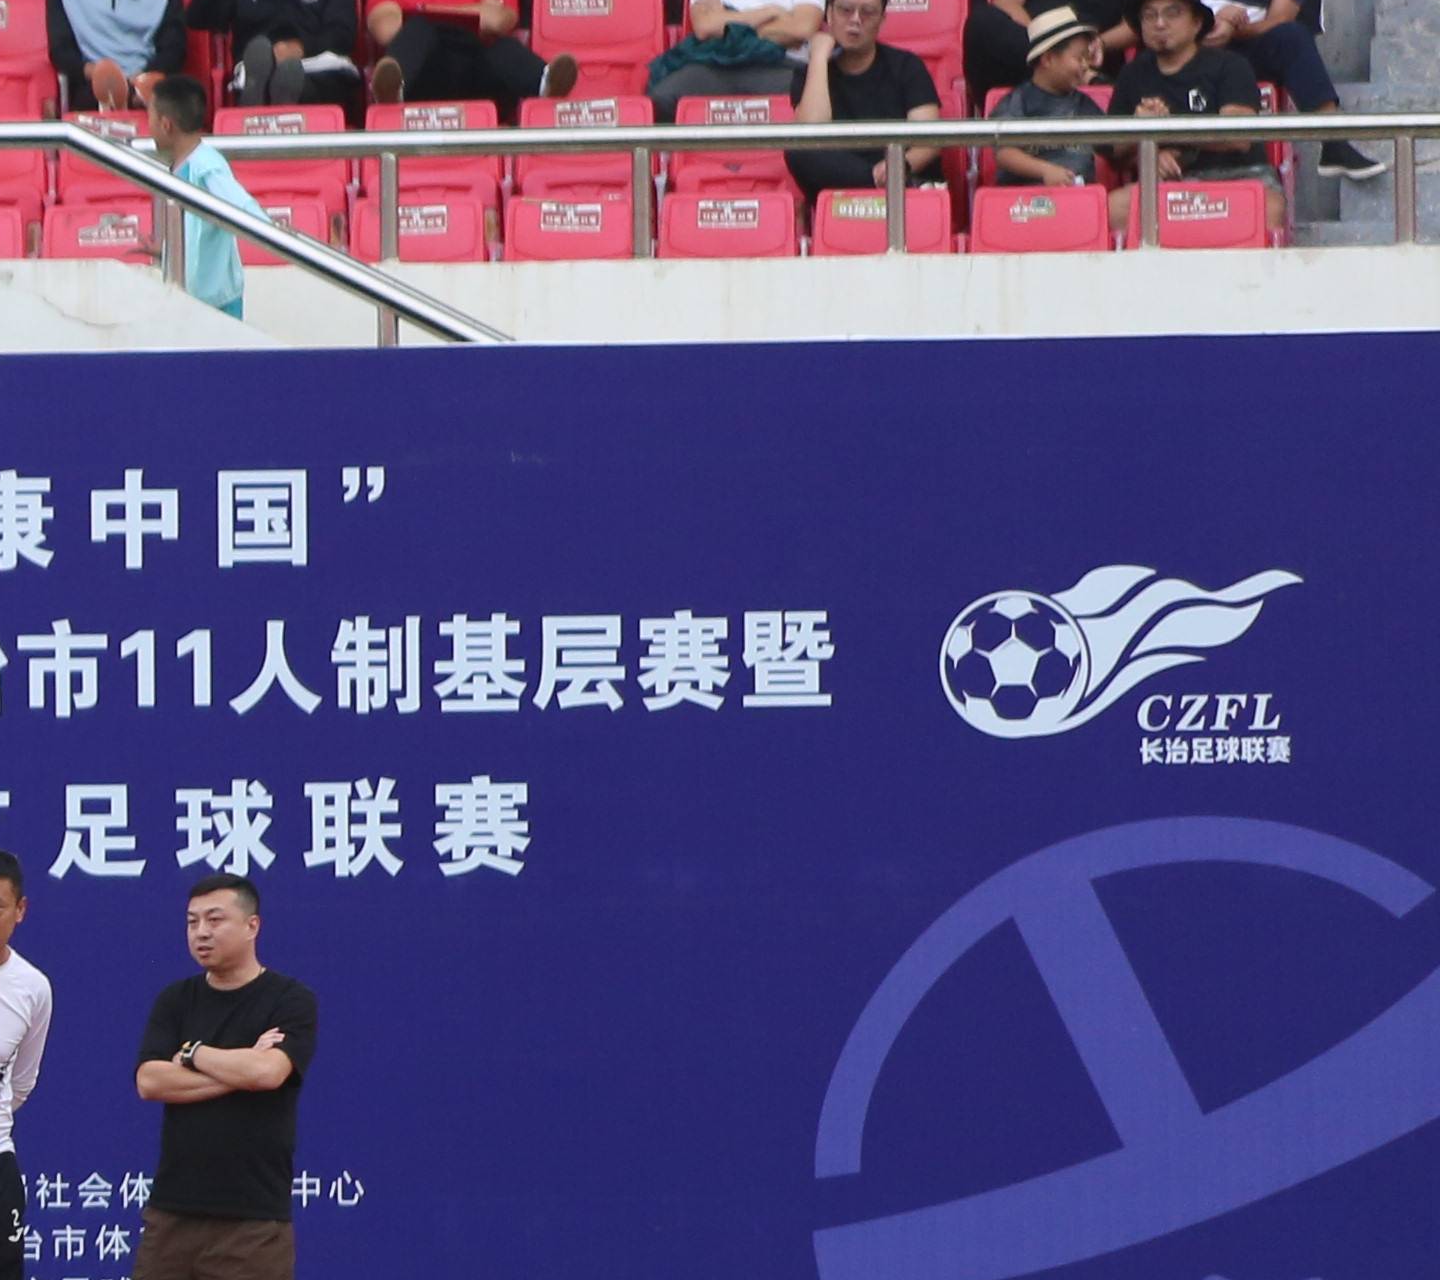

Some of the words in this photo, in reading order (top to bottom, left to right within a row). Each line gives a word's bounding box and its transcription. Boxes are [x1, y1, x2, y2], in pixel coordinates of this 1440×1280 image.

[1136, 693, 1281, 732] CZFL
[1140, 737, 1291, 765] 长治足球联赛
